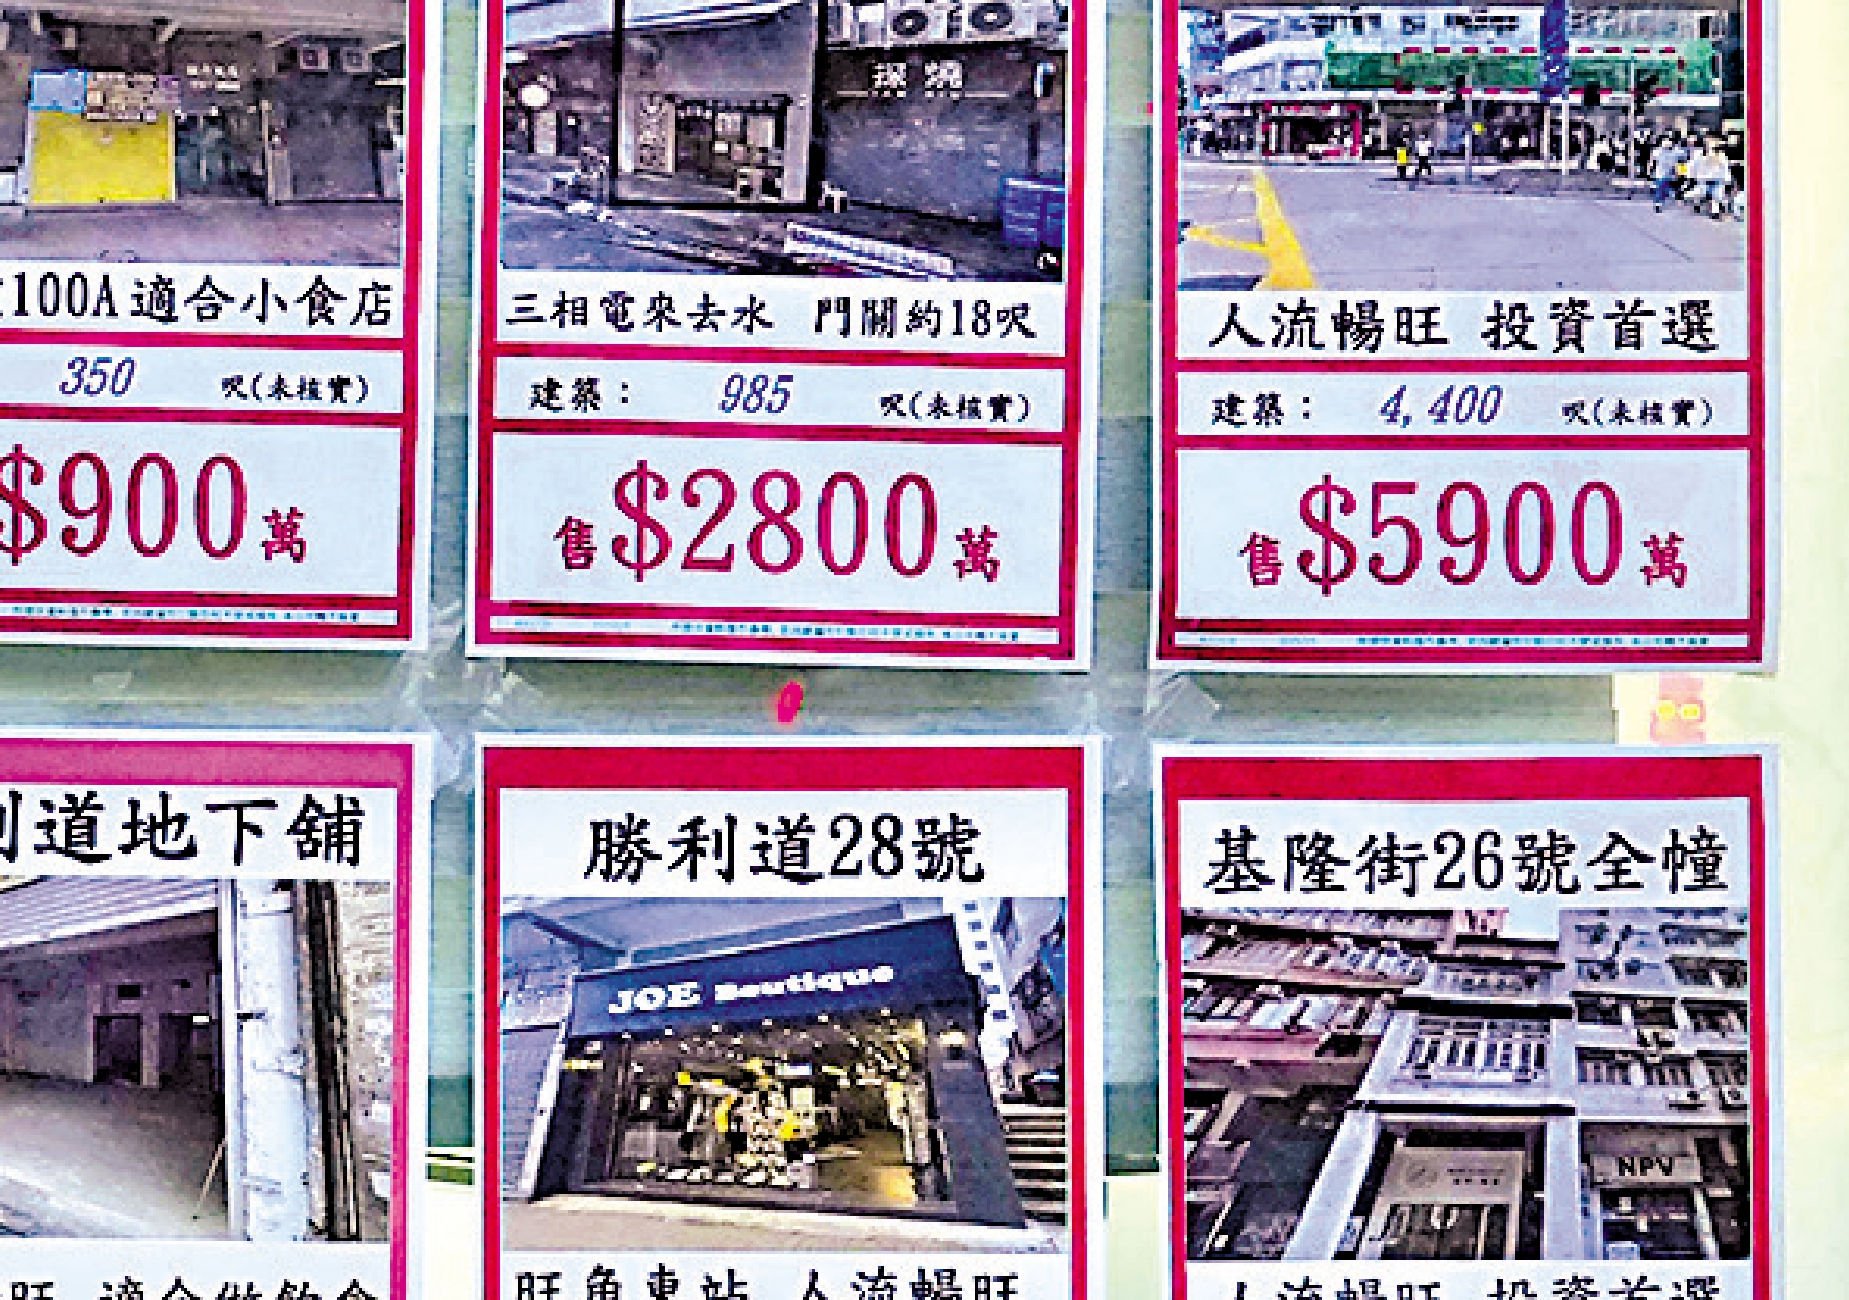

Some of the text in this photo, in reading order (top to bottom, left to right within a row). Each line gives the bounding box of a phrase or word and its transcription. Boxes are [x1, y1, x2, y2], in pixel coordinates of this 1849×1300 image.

[130, 276, 393, 328] 適合小食店
[1208, 300, 1719, 353] 人流暢旺 投資首選
[58, 357, 136, 396] 350
[718, 374, 794, 413] 985
[1379, 385, 1504, 428] 4,400
[583, 811, 987, 886] 勝利道28號
[1202, 825, 1730, 899] 基隆街26號全幢
[607, 979, 702, 1015] JOE
[1618, 1156, 1675, 1178] NPV
